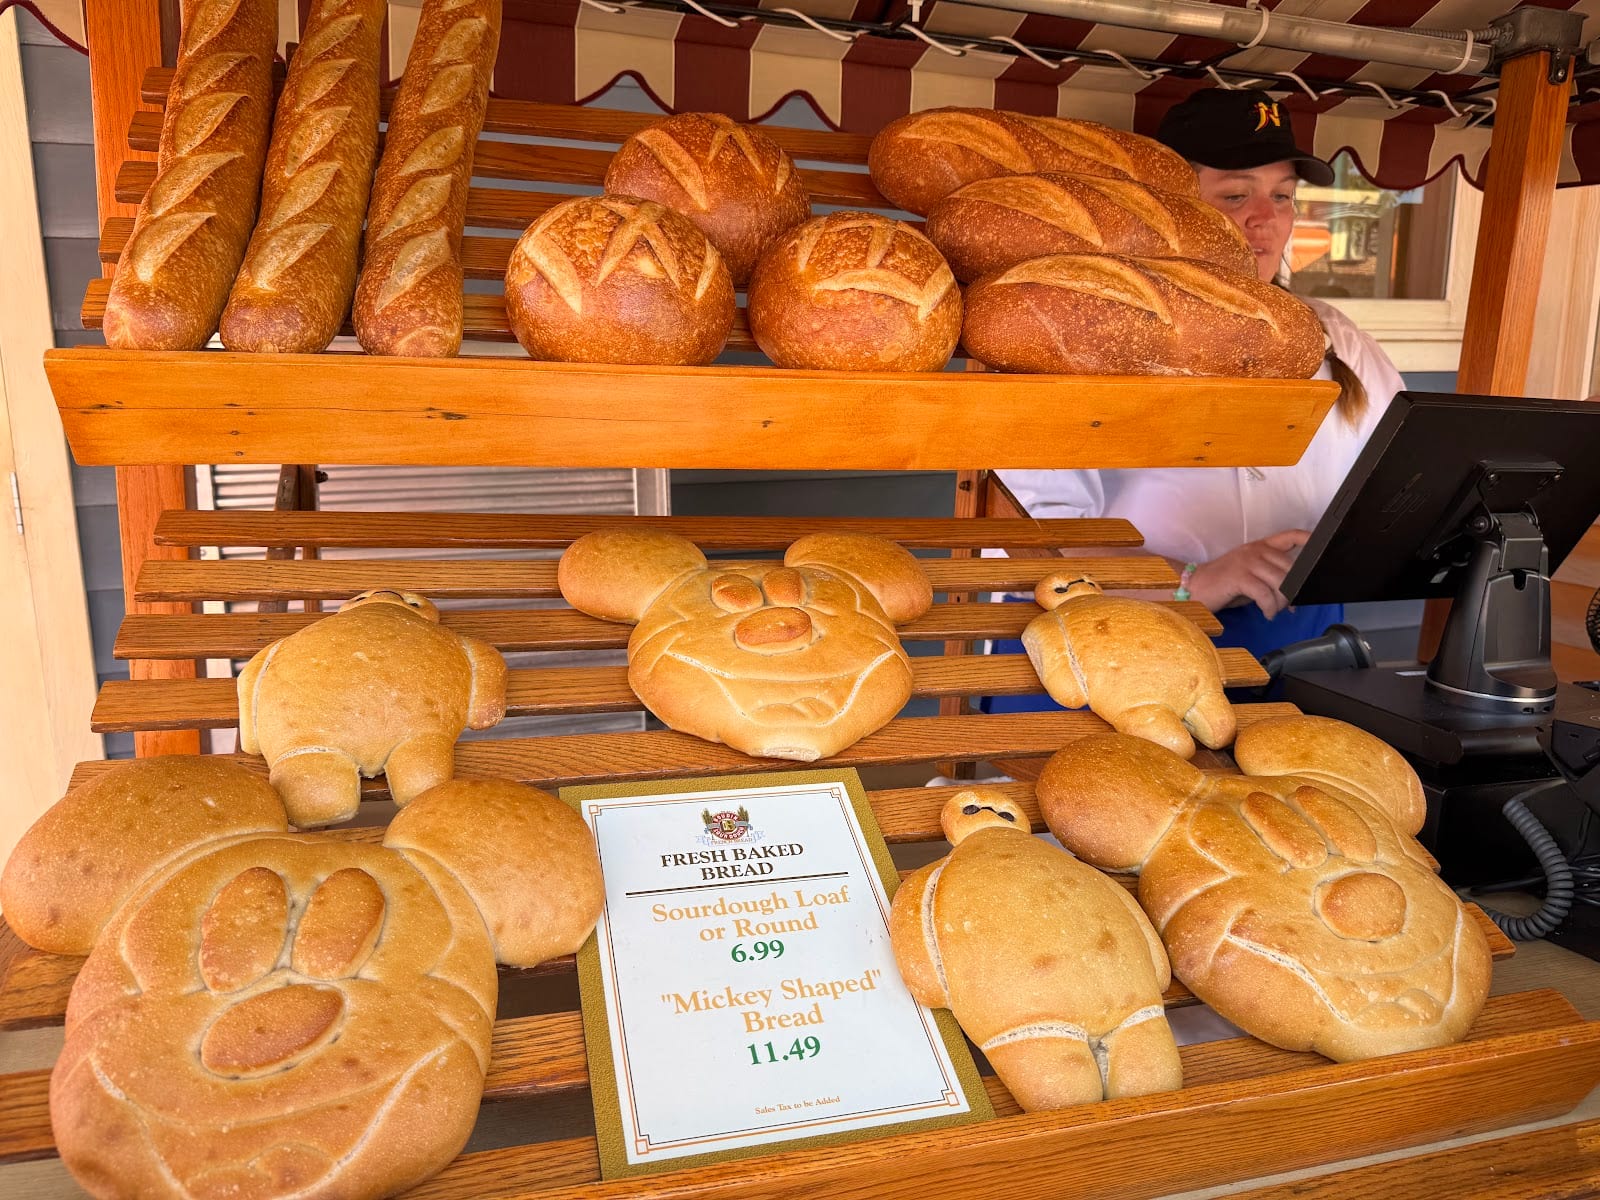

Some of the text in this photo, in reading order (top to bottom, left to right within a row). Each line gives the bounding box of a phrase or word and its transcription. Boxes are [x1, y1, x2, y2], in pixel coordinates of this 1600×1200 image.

[660, 843, 804, 867] FRESH BAKED
[701, 862, 774, 881] BREAD
[652, 885, 850, 922] Sourdough Loaf
[700, 911, 820, 942] or Round
[731, 939, 785, 963] 6.99
[661, 969, 882, 1015] "Mickey Shaped"
[741, 1002, 825, 1034] Bread
[747, 1035, 822, 1066] 11.49
[755, 1106, 776, 1115] Sales
[778, 1103, 792, 1111] Tax
[815, 1096, 841, 1106] Added
